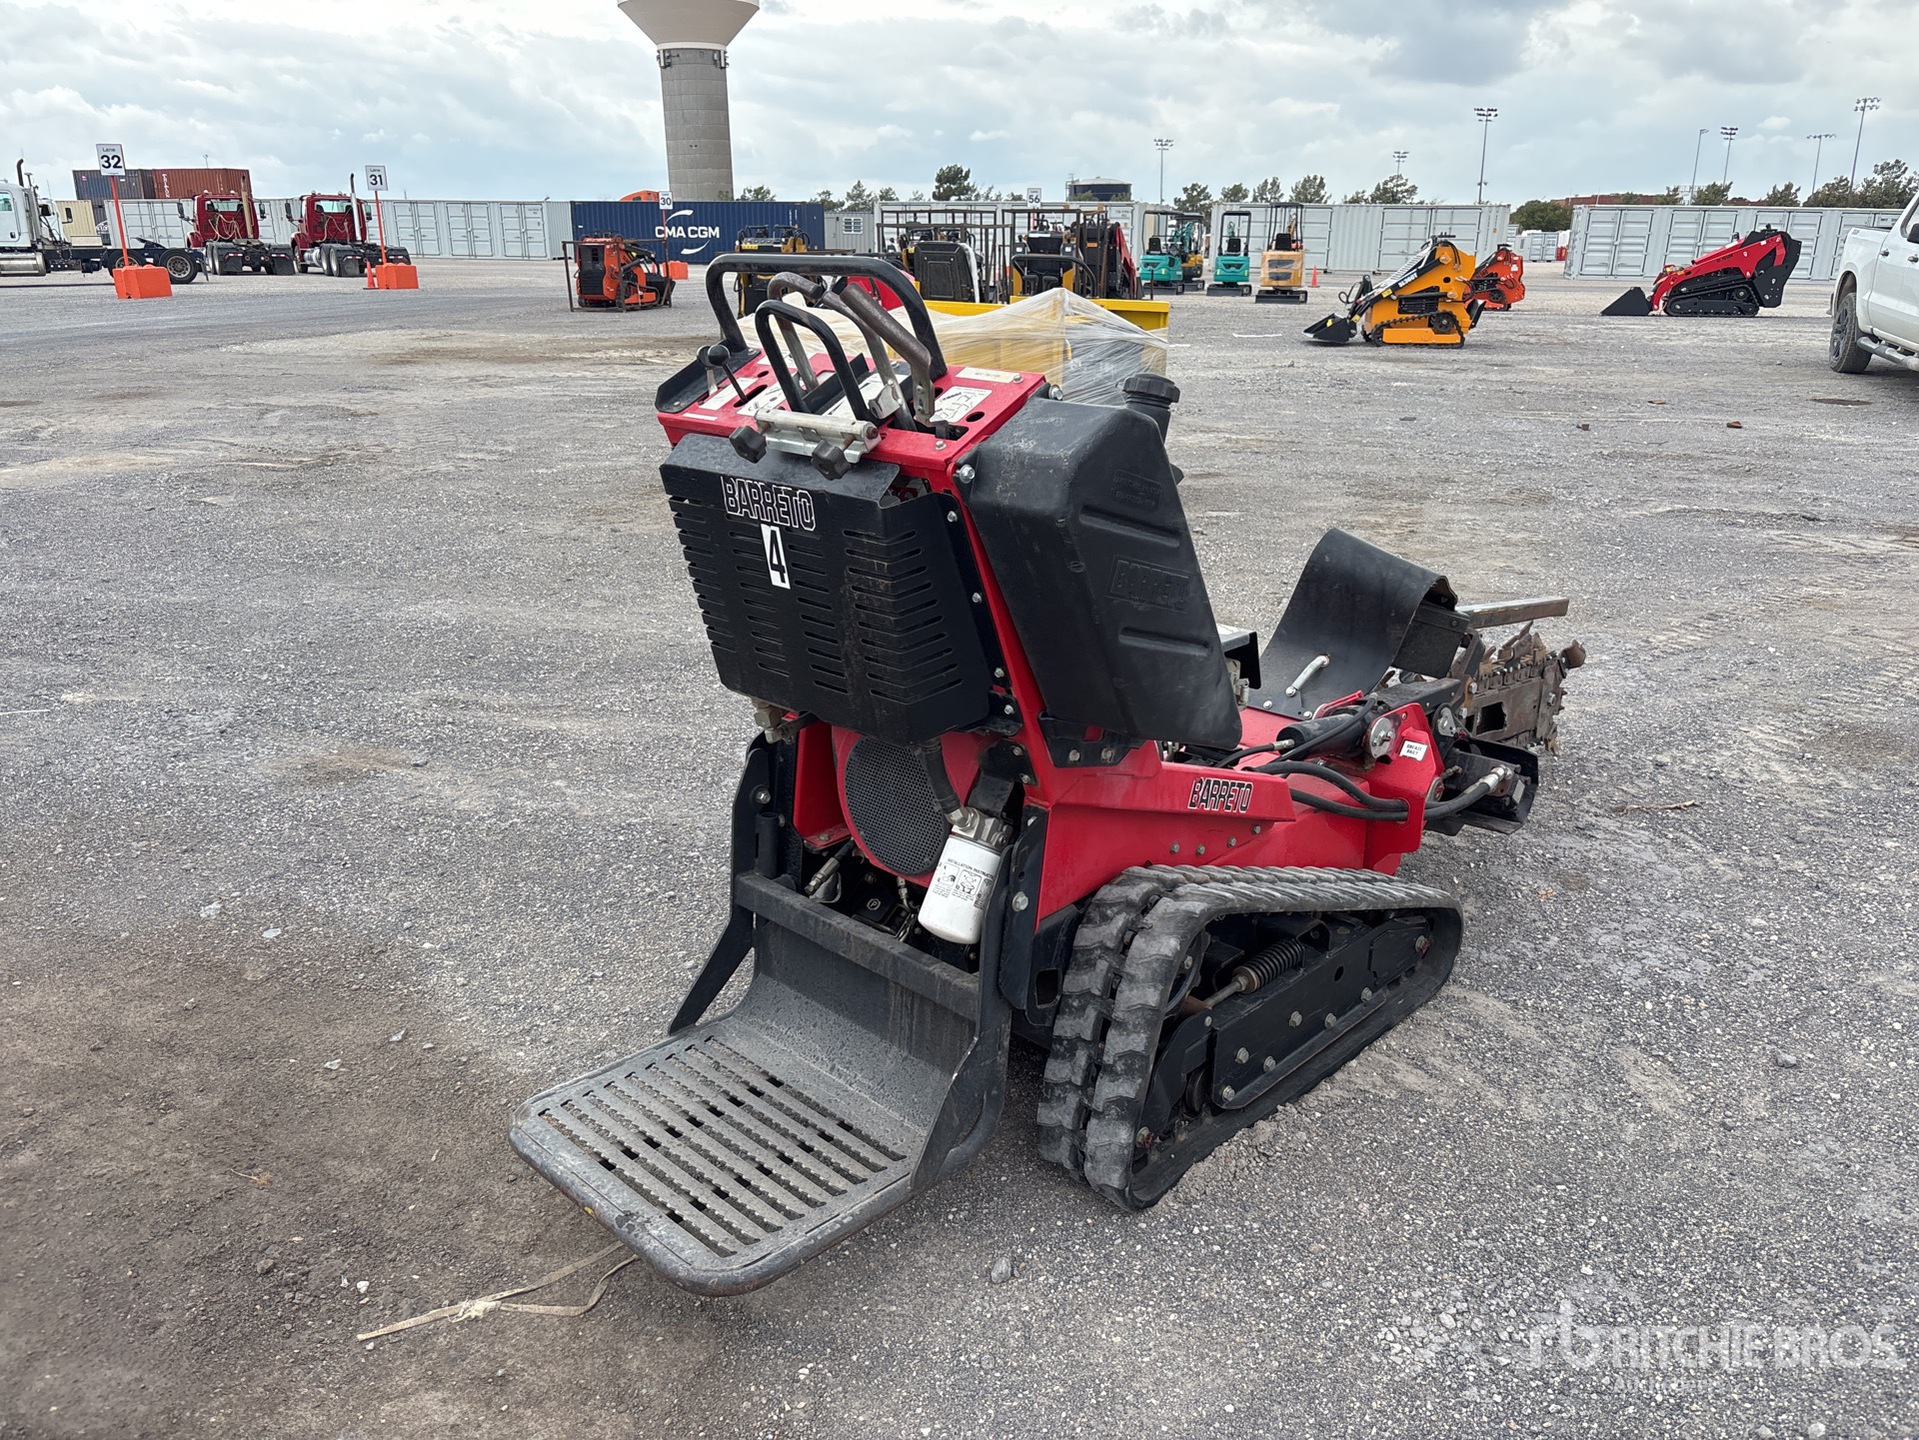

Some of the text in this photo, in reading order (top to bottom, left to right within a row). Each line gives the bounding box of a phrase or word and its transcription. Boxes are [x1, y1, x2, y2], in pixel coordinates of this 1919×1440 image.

[100, 154, 122, 170] 32
[369, 174, 383, 186] 31
[660, 197, 672, 206] 30
[1028, 194, 1040, 204] 56
[655, 226, 720, 239] CMA CGM
[720, 475, 816, 532] BARRETO
[769, 529, 787, 584] 4
[1187, 776, 1254, 814] BARRETO
